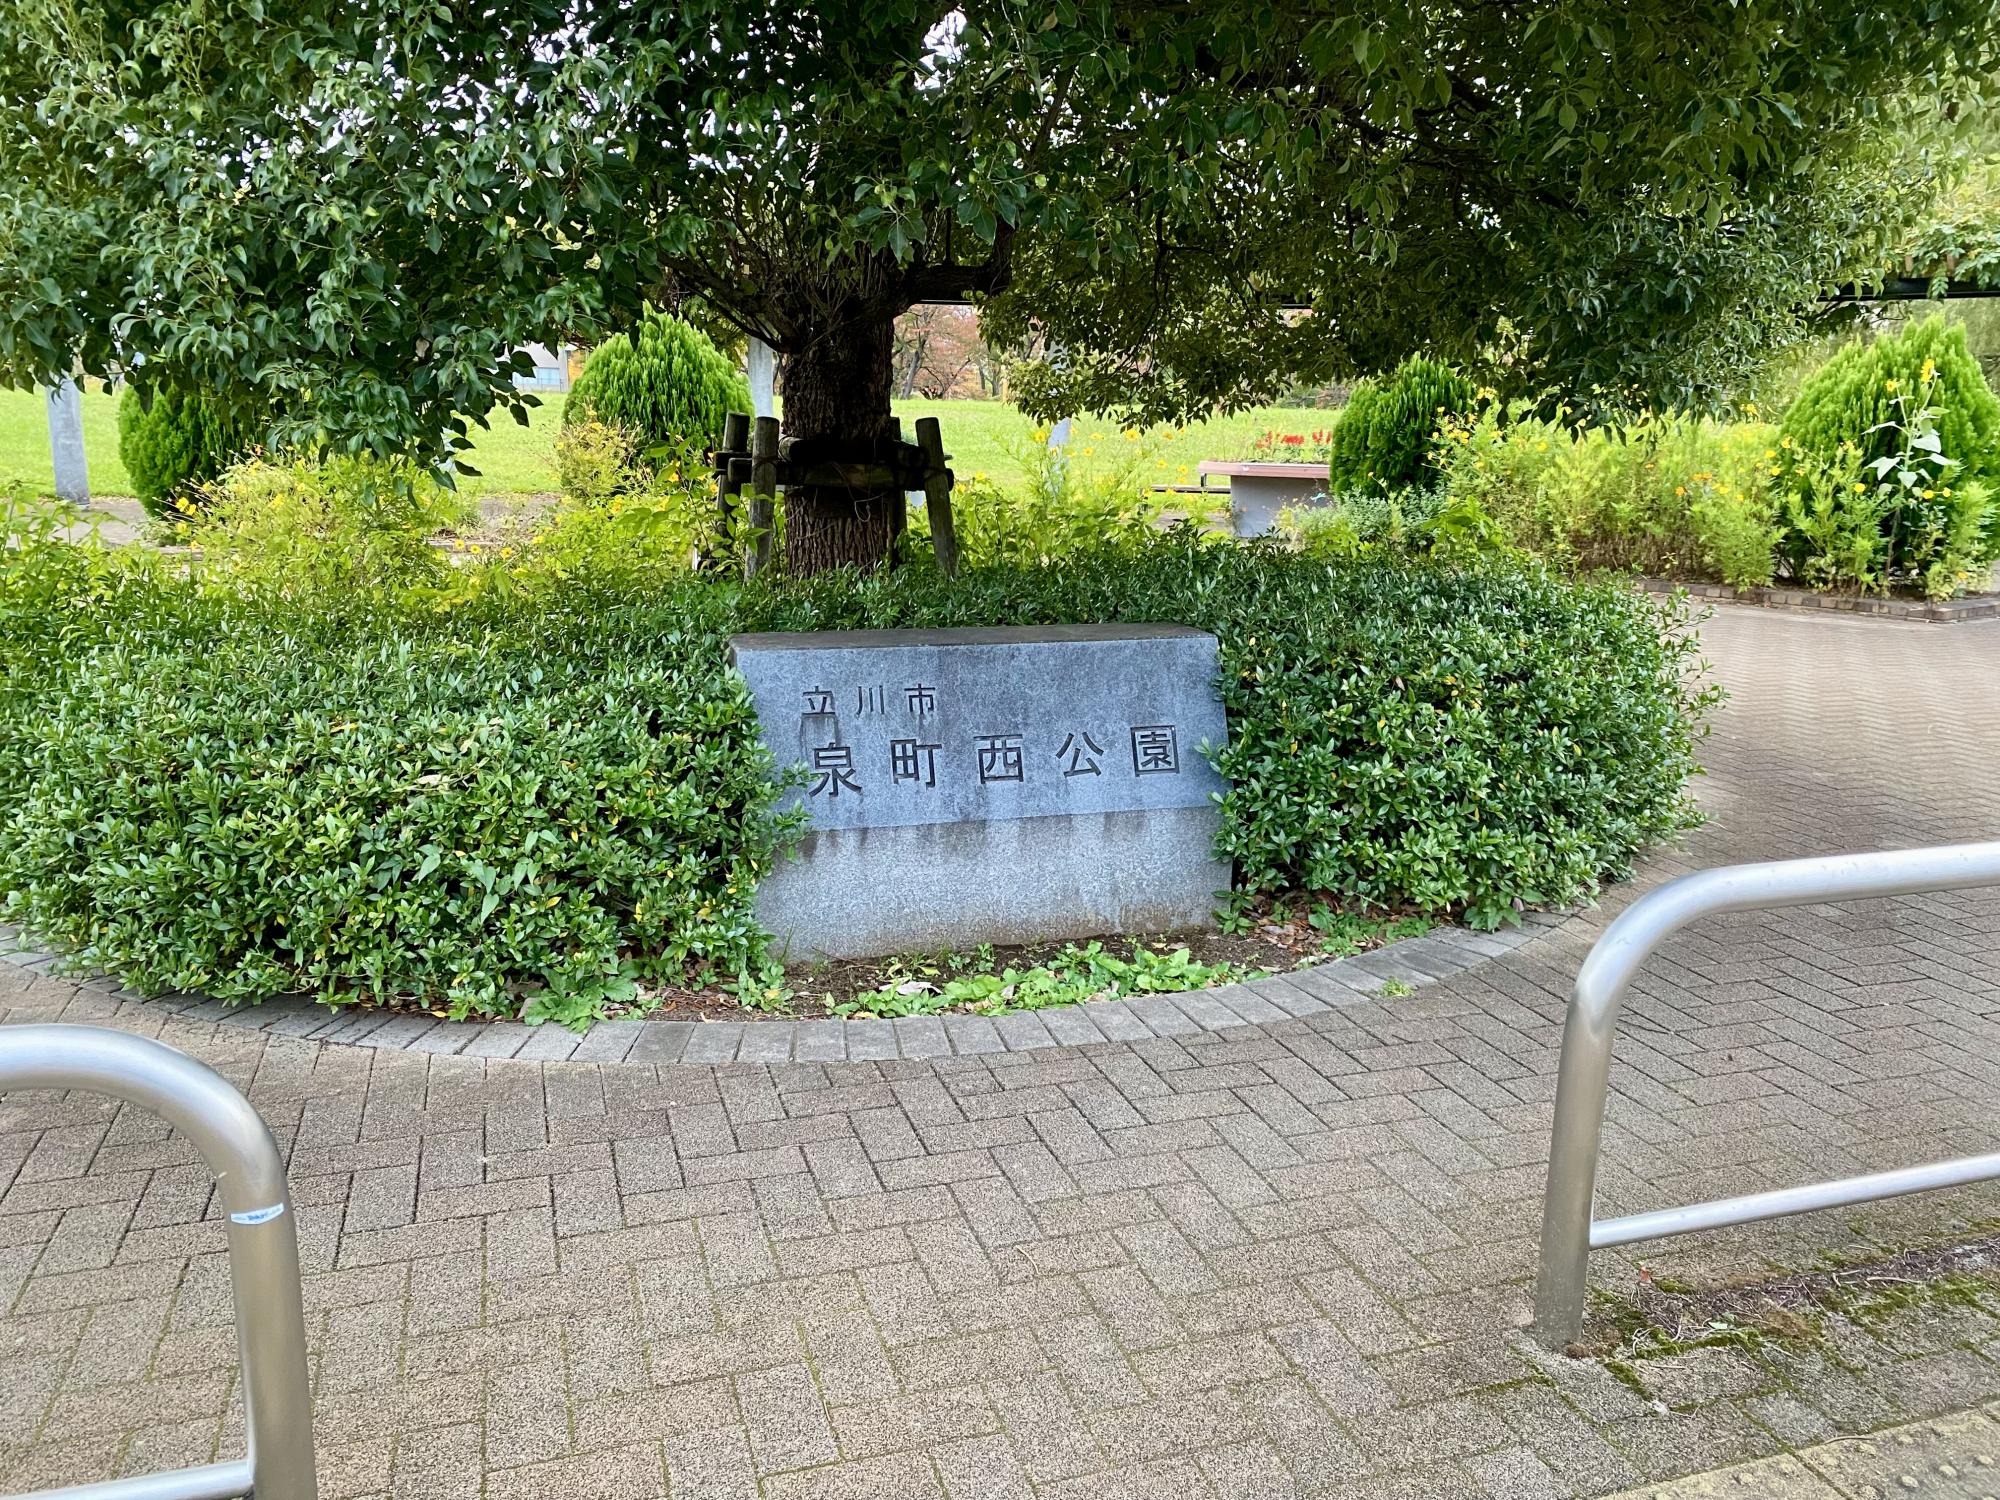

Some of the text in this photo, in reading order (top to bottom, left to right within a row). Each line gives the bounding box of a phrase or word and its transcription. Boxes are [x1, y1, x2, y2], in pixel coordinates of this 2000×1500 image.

[801, 683, 936, 718] 立川市
[808, 724, 1180, 797] 泉町西公園
